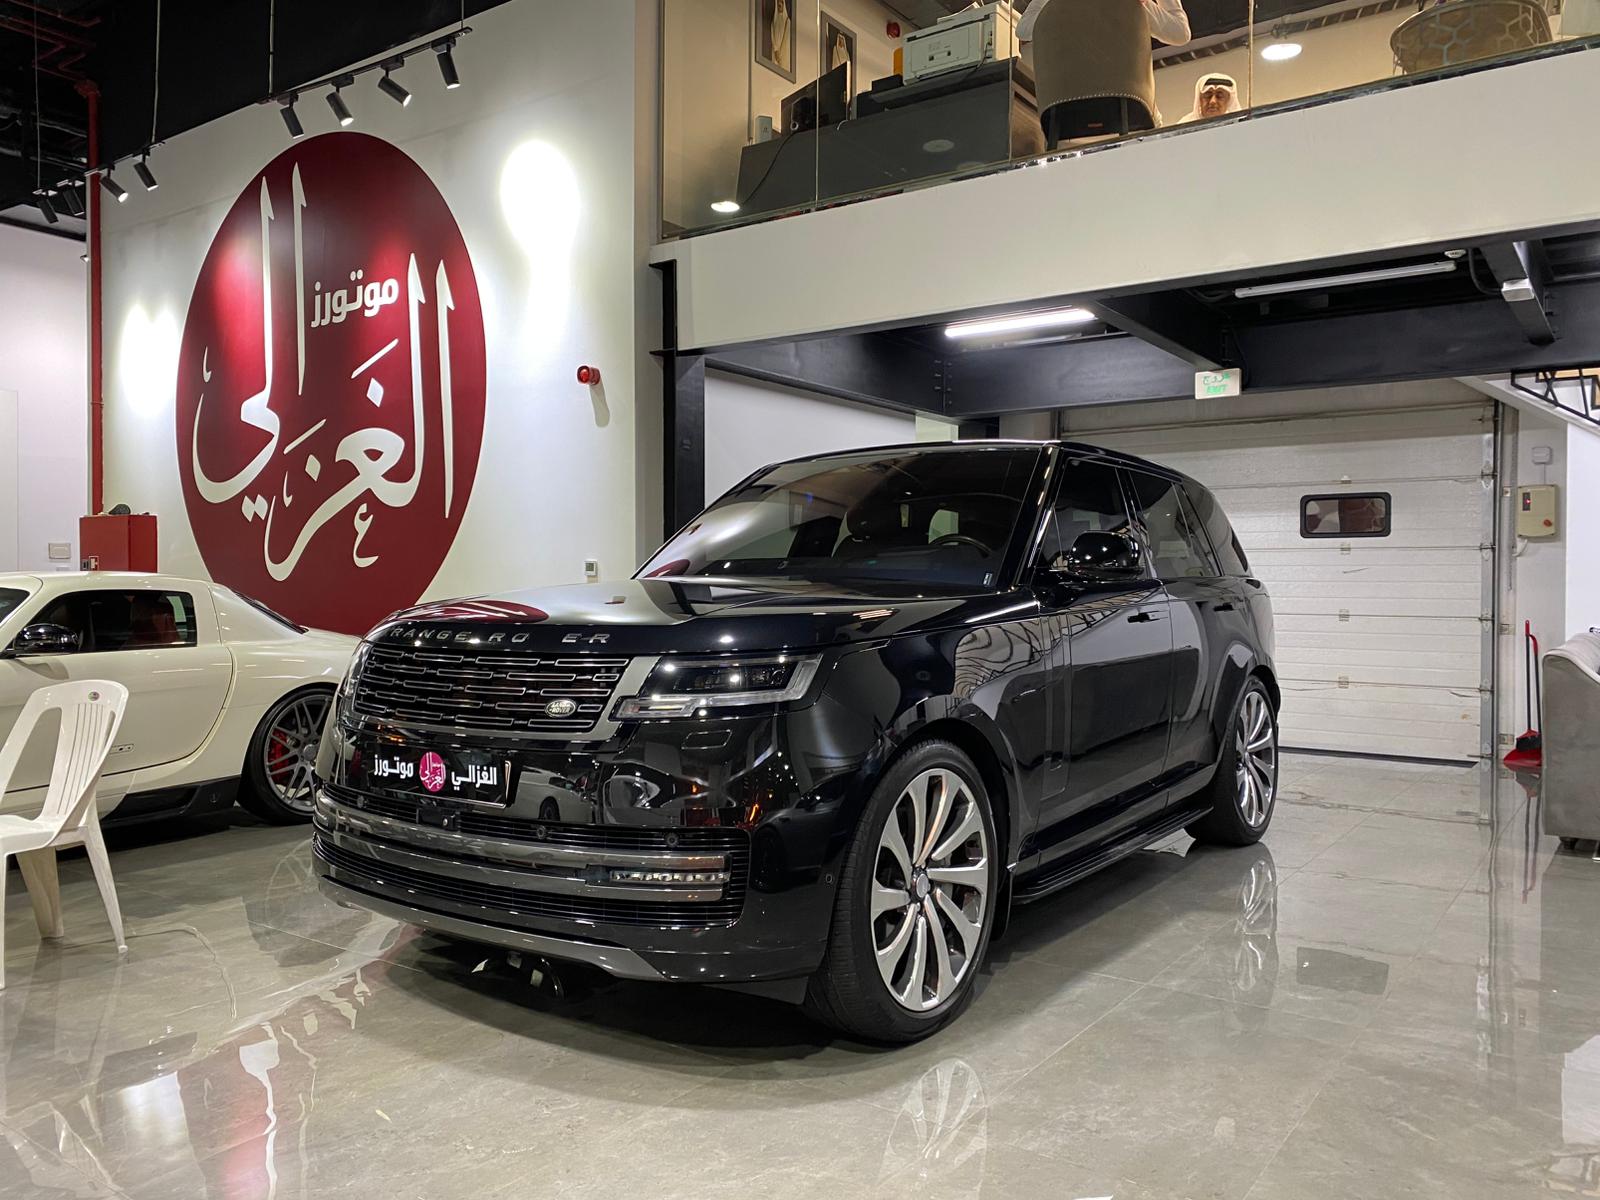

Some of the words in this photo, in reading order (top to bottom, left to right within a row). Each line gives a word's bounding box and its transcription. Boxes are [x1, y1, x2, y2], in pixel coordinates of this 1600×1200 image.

[311, 270, 400, 328] موتورز
[389, 627, 473, 642] RANGE
[488, 632, 611, 644] ROER
[374, 754, 414, 780] موتورز
[451, 764, 498, 791] الغزالي
